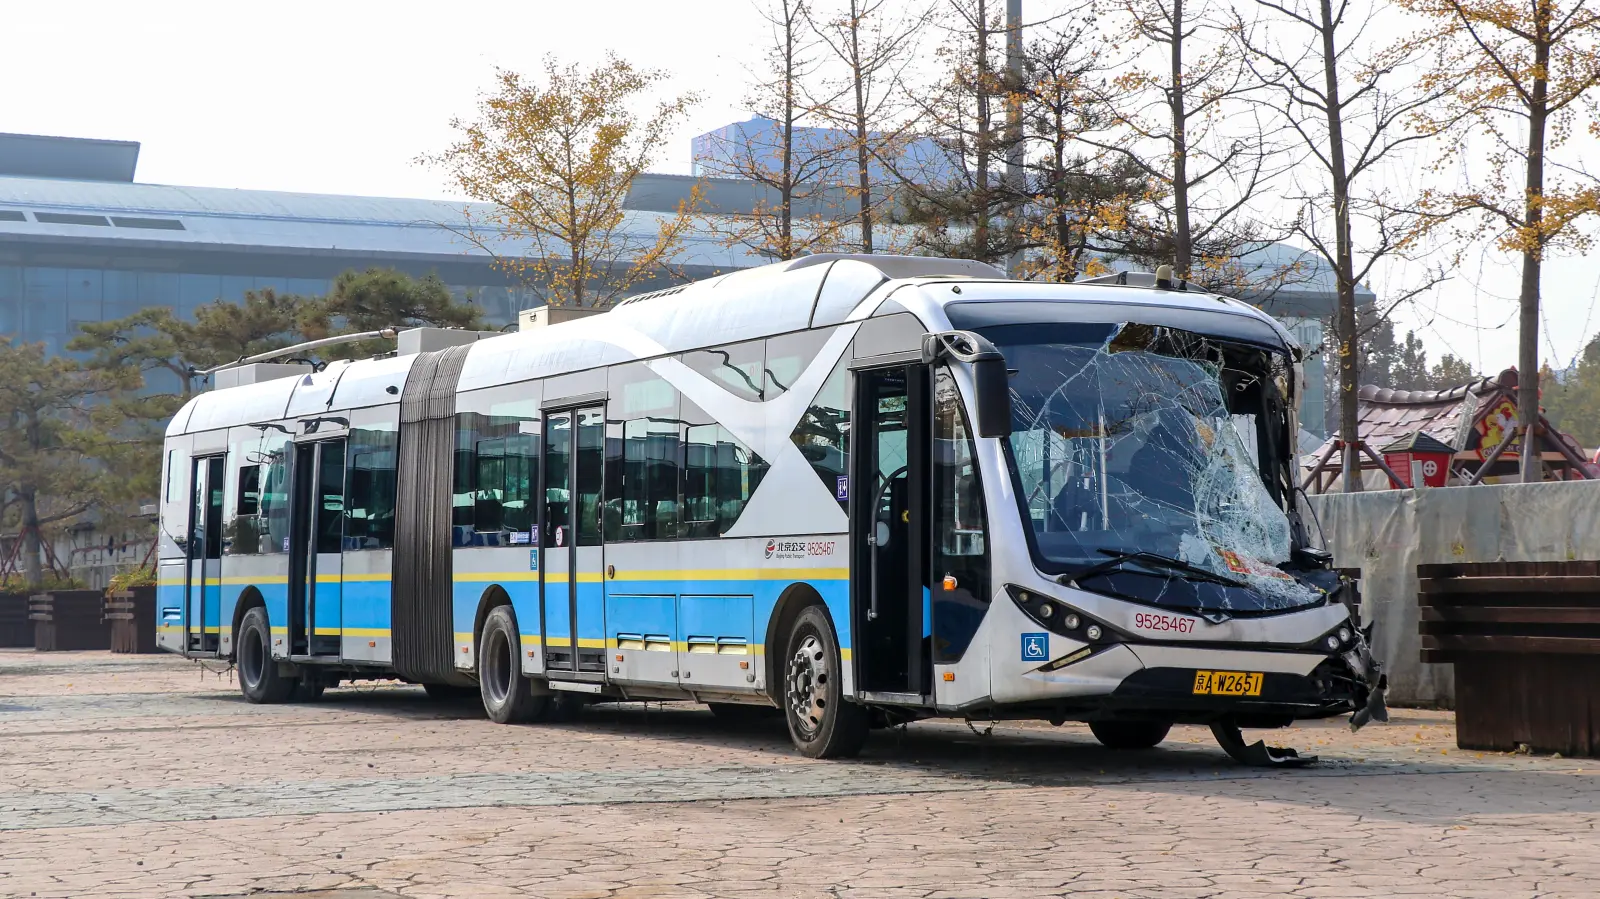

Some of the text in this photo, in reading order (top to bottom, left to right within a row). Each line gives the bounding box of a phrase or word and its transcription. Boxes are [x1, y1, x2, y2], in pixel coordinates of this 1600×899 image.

[776, 542, 806, 552] 北京公交
[807, 541, 835, 556] 9525467
[1135, 613, 1195, 633] 9525467
